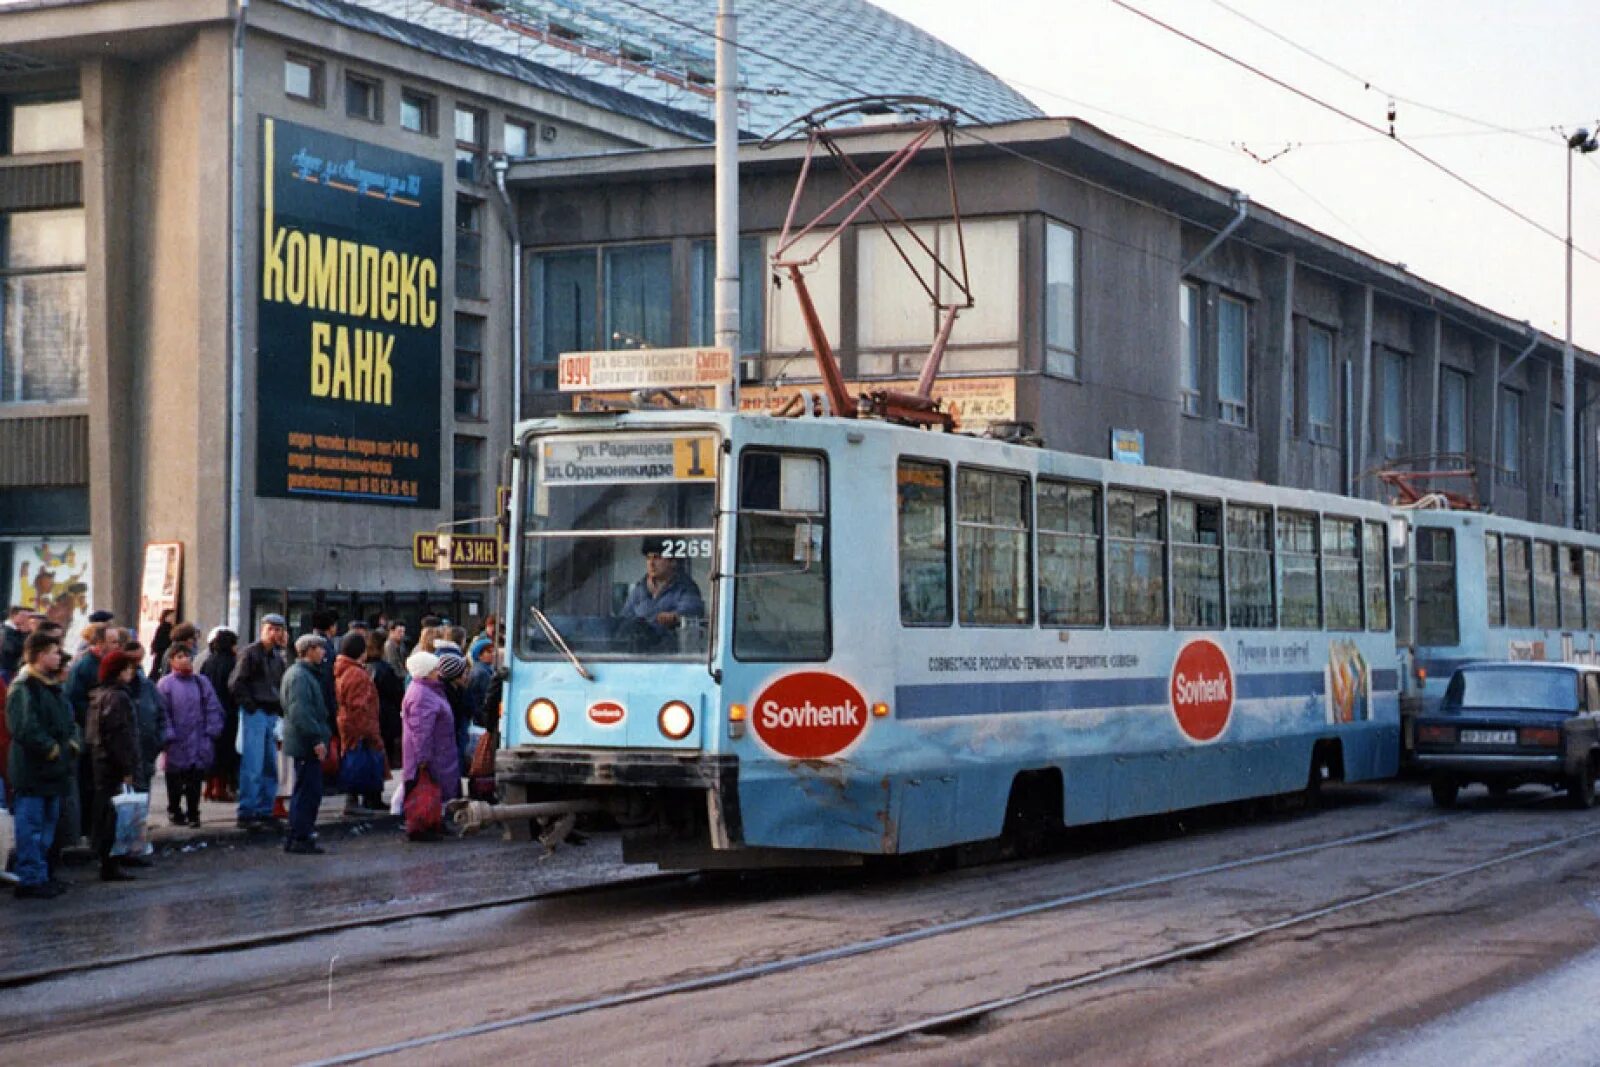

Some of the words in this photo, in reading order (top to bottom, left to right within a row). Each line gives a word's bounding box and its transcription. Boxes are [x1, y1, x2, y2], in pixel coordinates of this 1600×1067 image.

[311, 321, 395, 406] БАНК
[561, 356, 591, 385] 1994
[600, 441, 674, 458] Радищева
[687, 439, 705, 475] 1
[565, 461, 674, 480] Орджоникидзе
[422, 540, 495, 563] МАЗИН
[662, 540, 712, 559] 2269
[1176, 671, 1228, 707] Sovhenk
[762, 700, 859, 729] Sovhenk
